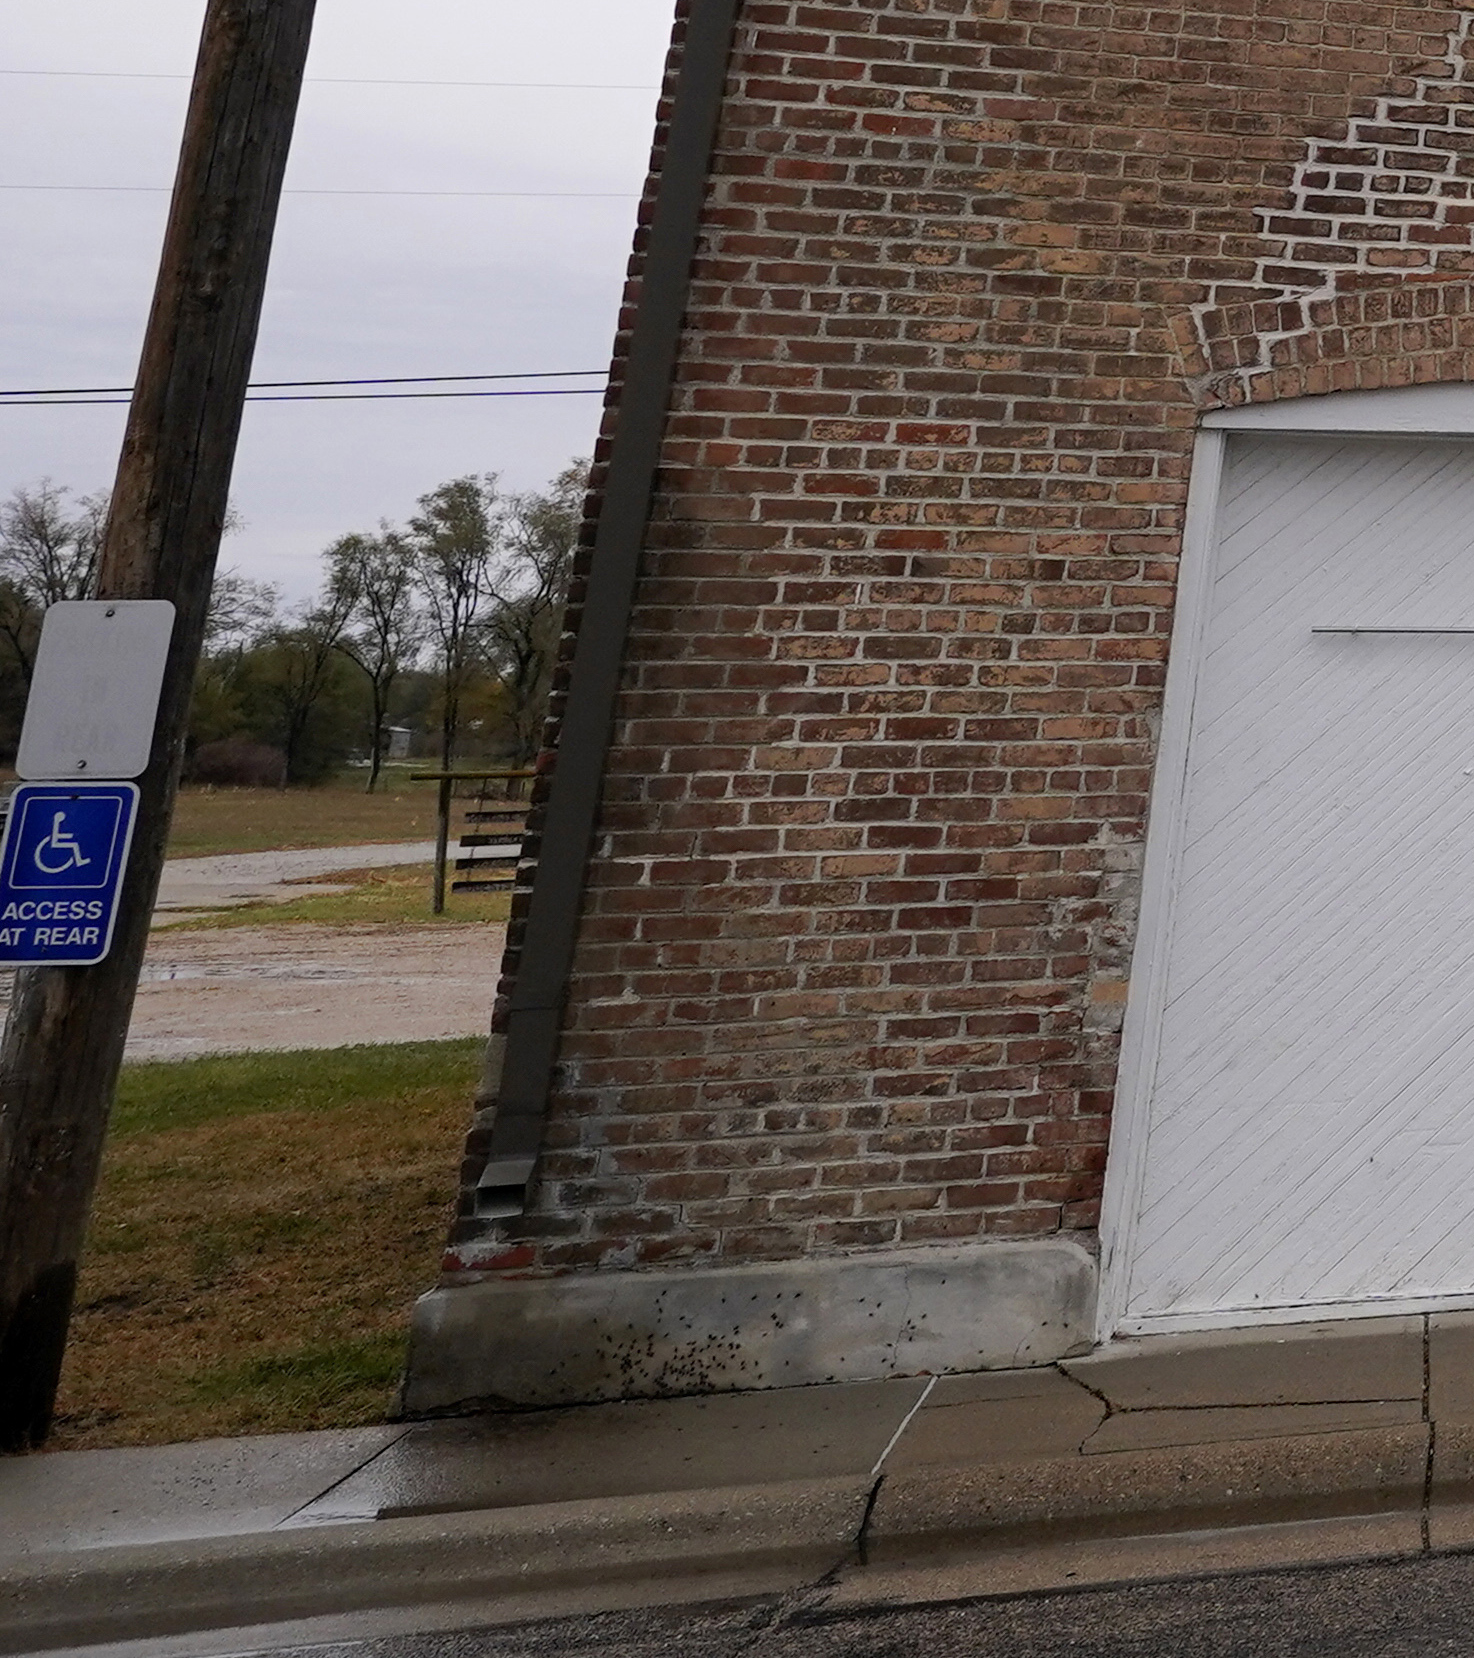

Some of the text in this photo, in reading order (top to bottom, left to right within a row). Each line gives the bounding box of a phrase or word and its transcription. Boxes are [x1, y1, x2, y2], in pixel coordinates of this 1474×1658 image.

[1, 900, 104, 920] ACCESS
[0, 926, 100, 946] AT REAR
